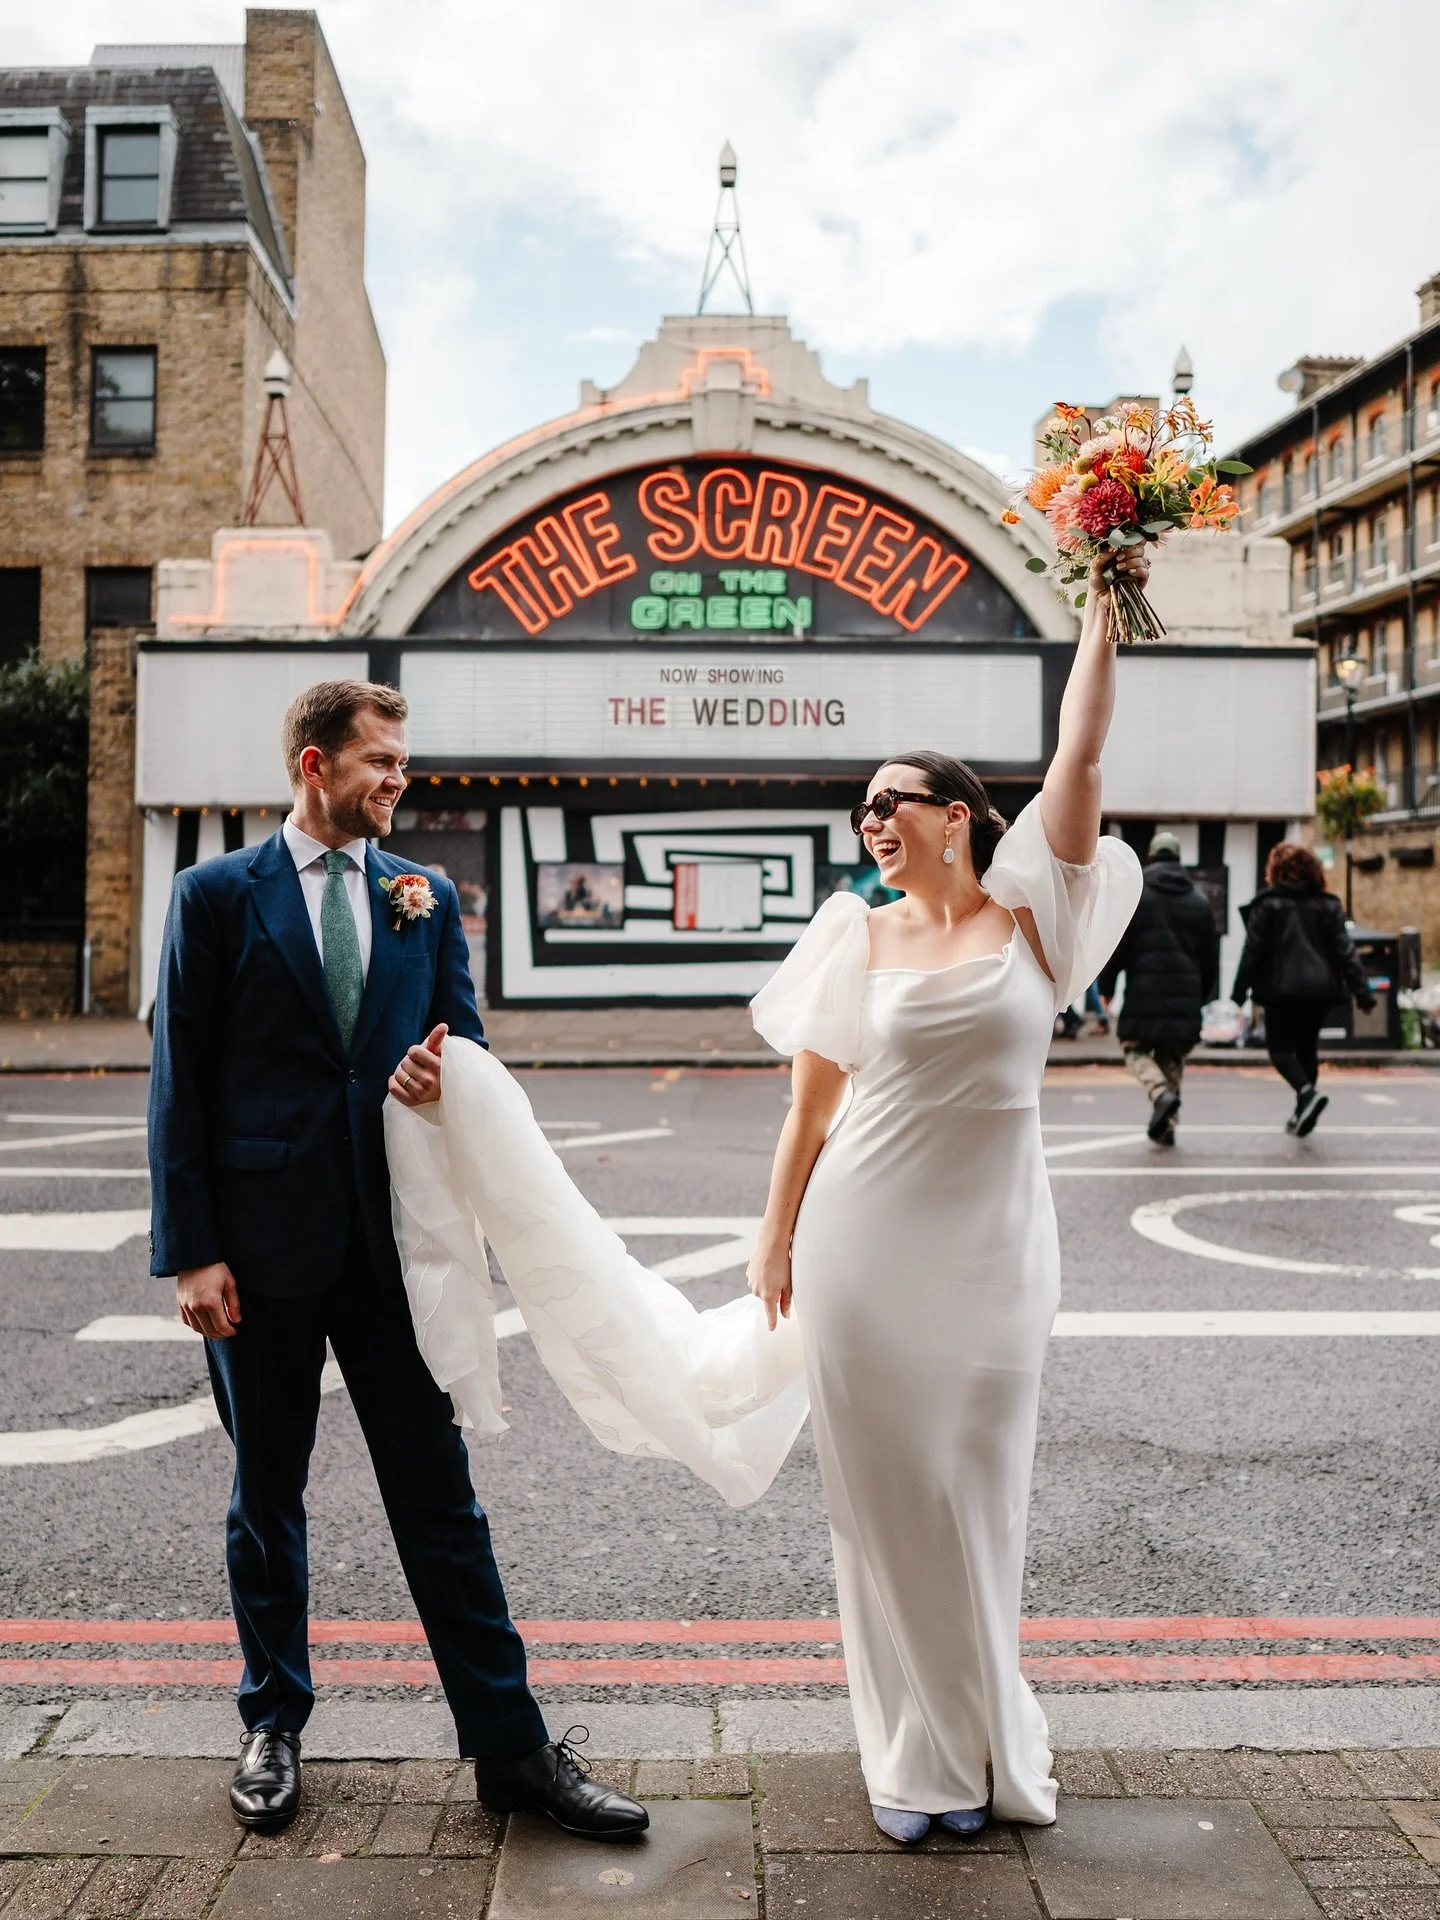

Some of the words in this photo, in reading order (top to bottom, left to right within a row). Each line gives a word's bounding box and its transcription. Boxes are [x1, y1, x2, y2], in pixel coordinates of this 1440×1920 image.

[468, 491, 636, 634] THE
[638, 467, 969, 633] SCREEN
[650, 570, 702, 595] ON
[718, 569, 787, 594] THE
[631, 596, 812, 629] GREEN
[660, 668, 698, 683] NOW
[707, 668, 784, 684] SHOWING
[608, 697, 666, 726] THE
[692, 697, 845, 726] WEDDING
